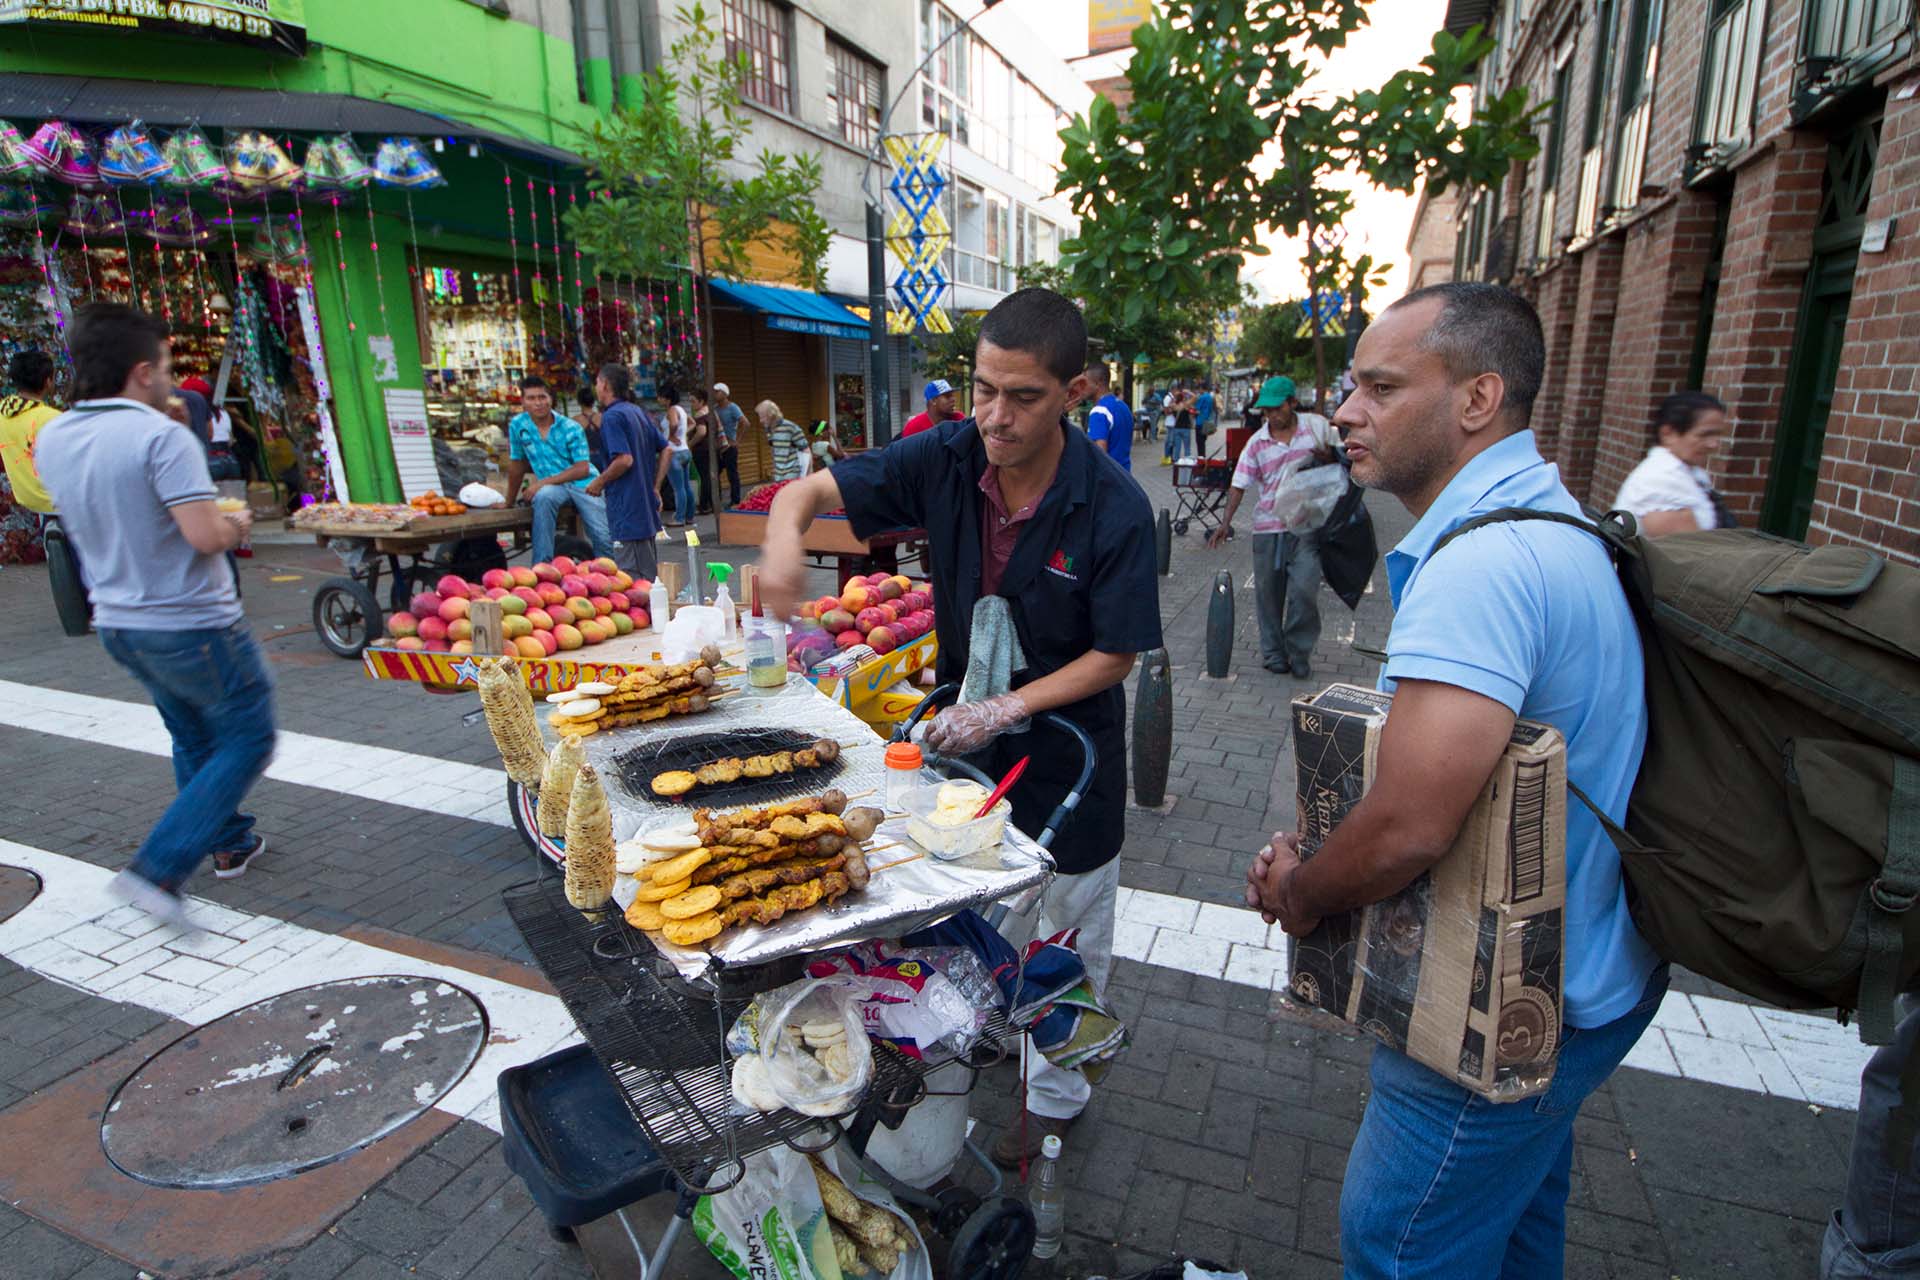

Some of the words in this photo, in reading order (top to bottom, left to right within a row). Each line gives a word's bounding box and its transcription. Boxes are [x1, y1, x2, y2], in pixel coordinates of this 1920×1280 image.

[168, 1, 213, 26] 448
[214, 8, 243, 32] 53
[1500, 1026, 1531, 1051] 3
